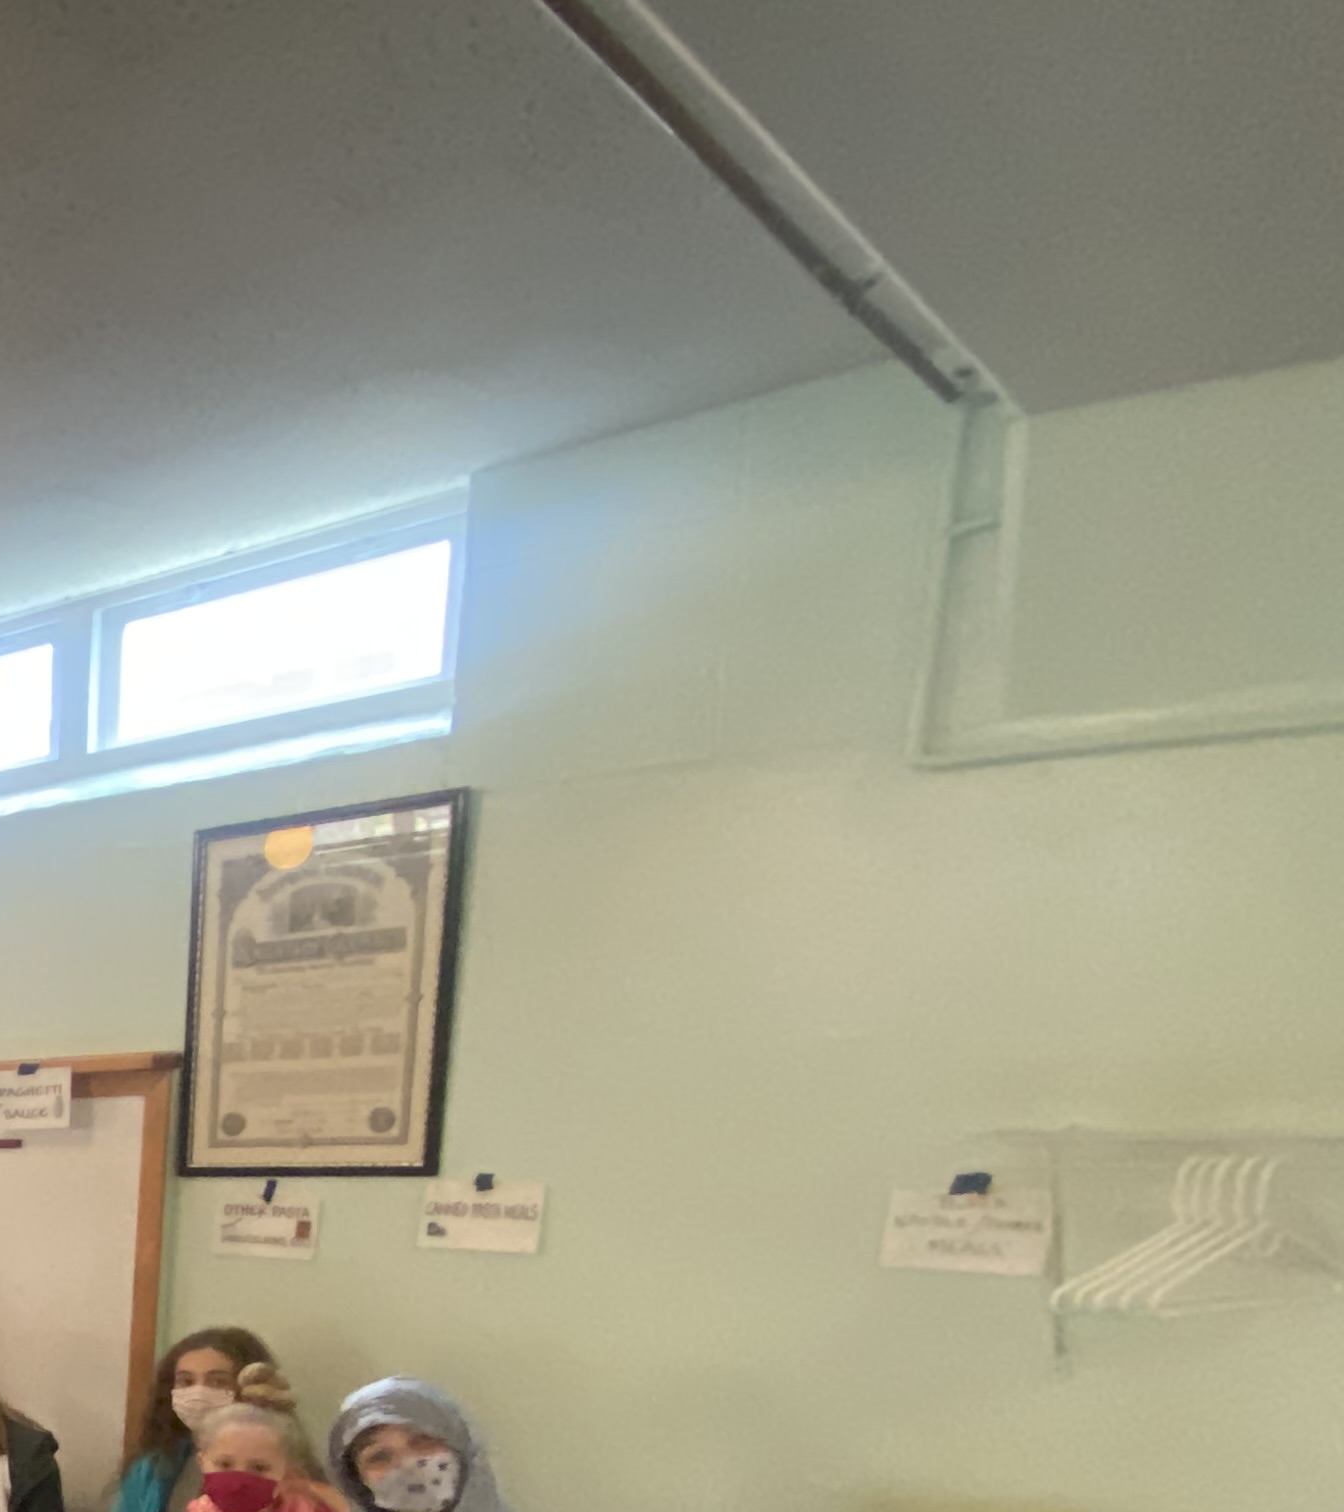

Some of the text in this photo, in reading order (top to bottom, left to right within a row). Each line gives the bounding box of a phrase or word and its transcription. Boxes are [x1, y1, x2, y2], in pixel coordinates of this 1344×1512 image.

[3, 1107, 49, 1121] SAUCE
[223, 1202, 311, 1218] OTHER PASTA
